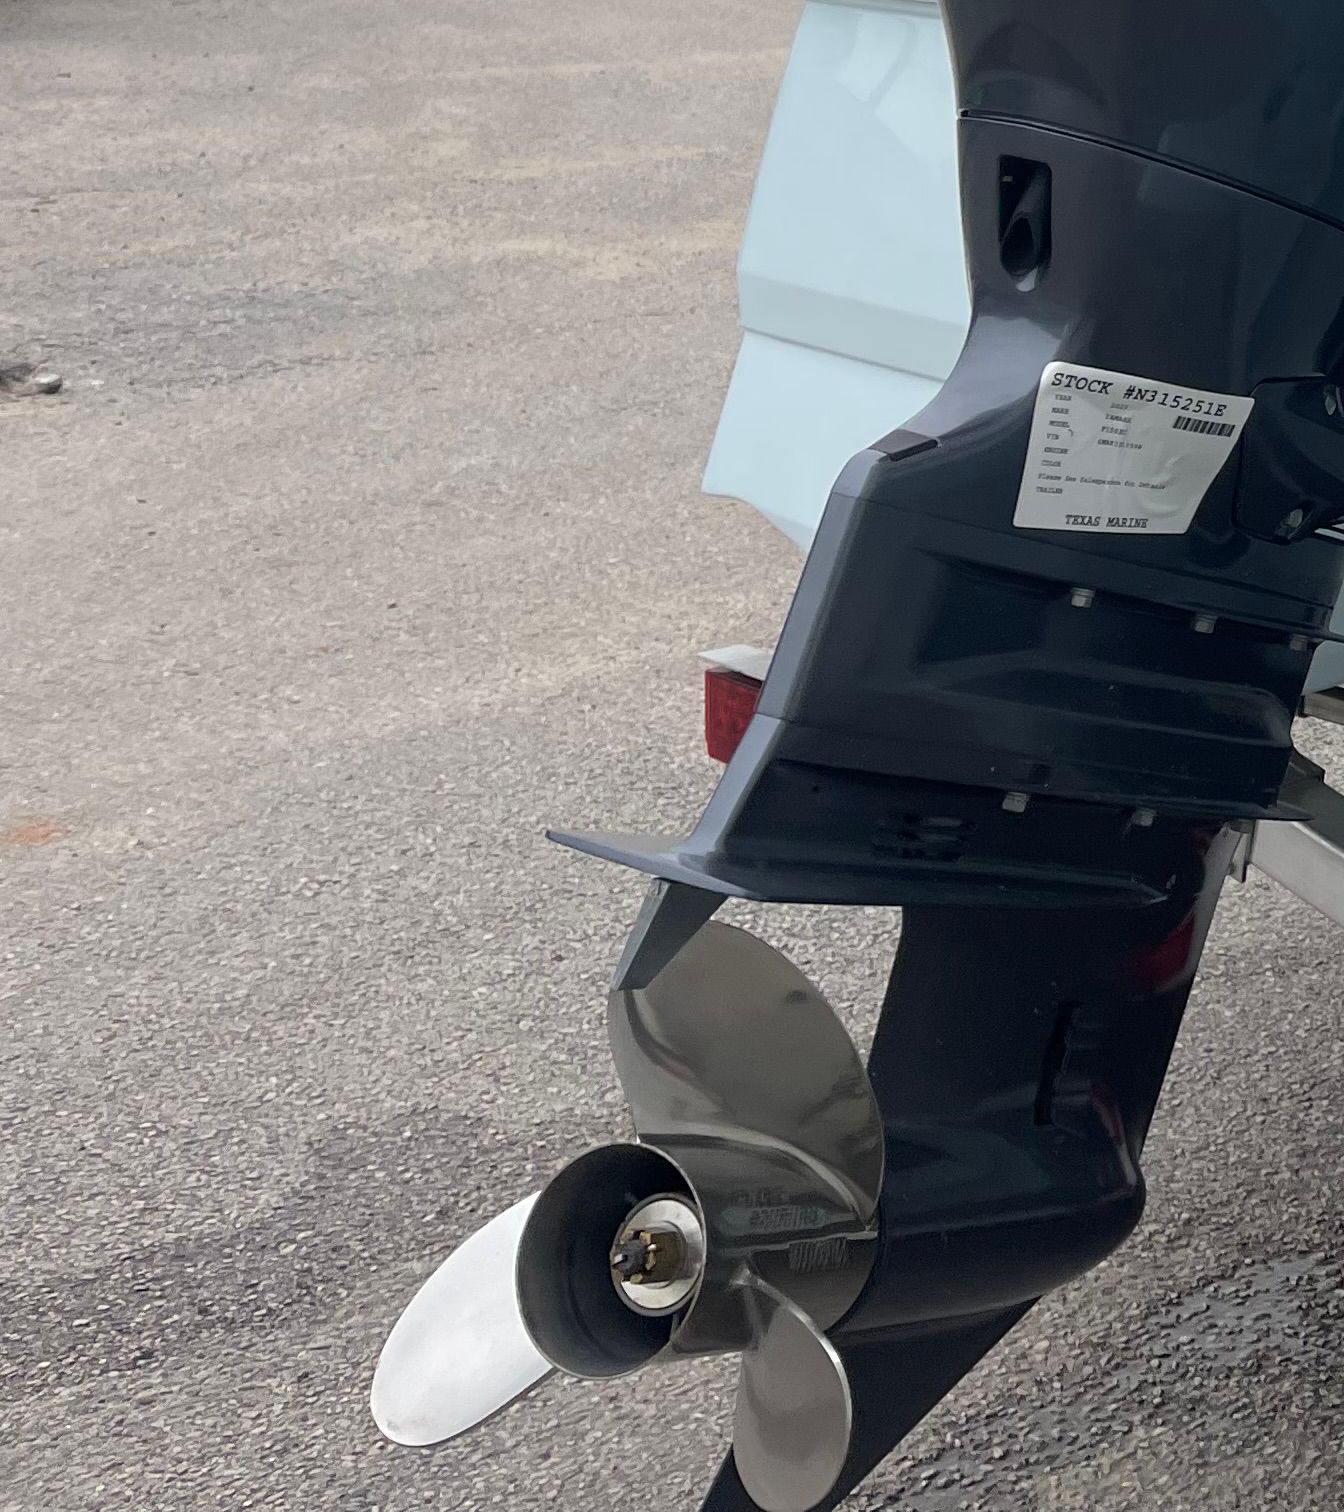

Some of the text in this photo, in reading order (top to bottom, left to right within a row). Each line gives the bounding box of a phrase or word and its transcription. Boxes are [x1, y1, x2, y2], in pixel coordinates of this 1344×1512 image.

[1051, 373, 1228, 417] STOCK #N315251E
[1066, 515, 1149, 529] TEXAS MARINE
